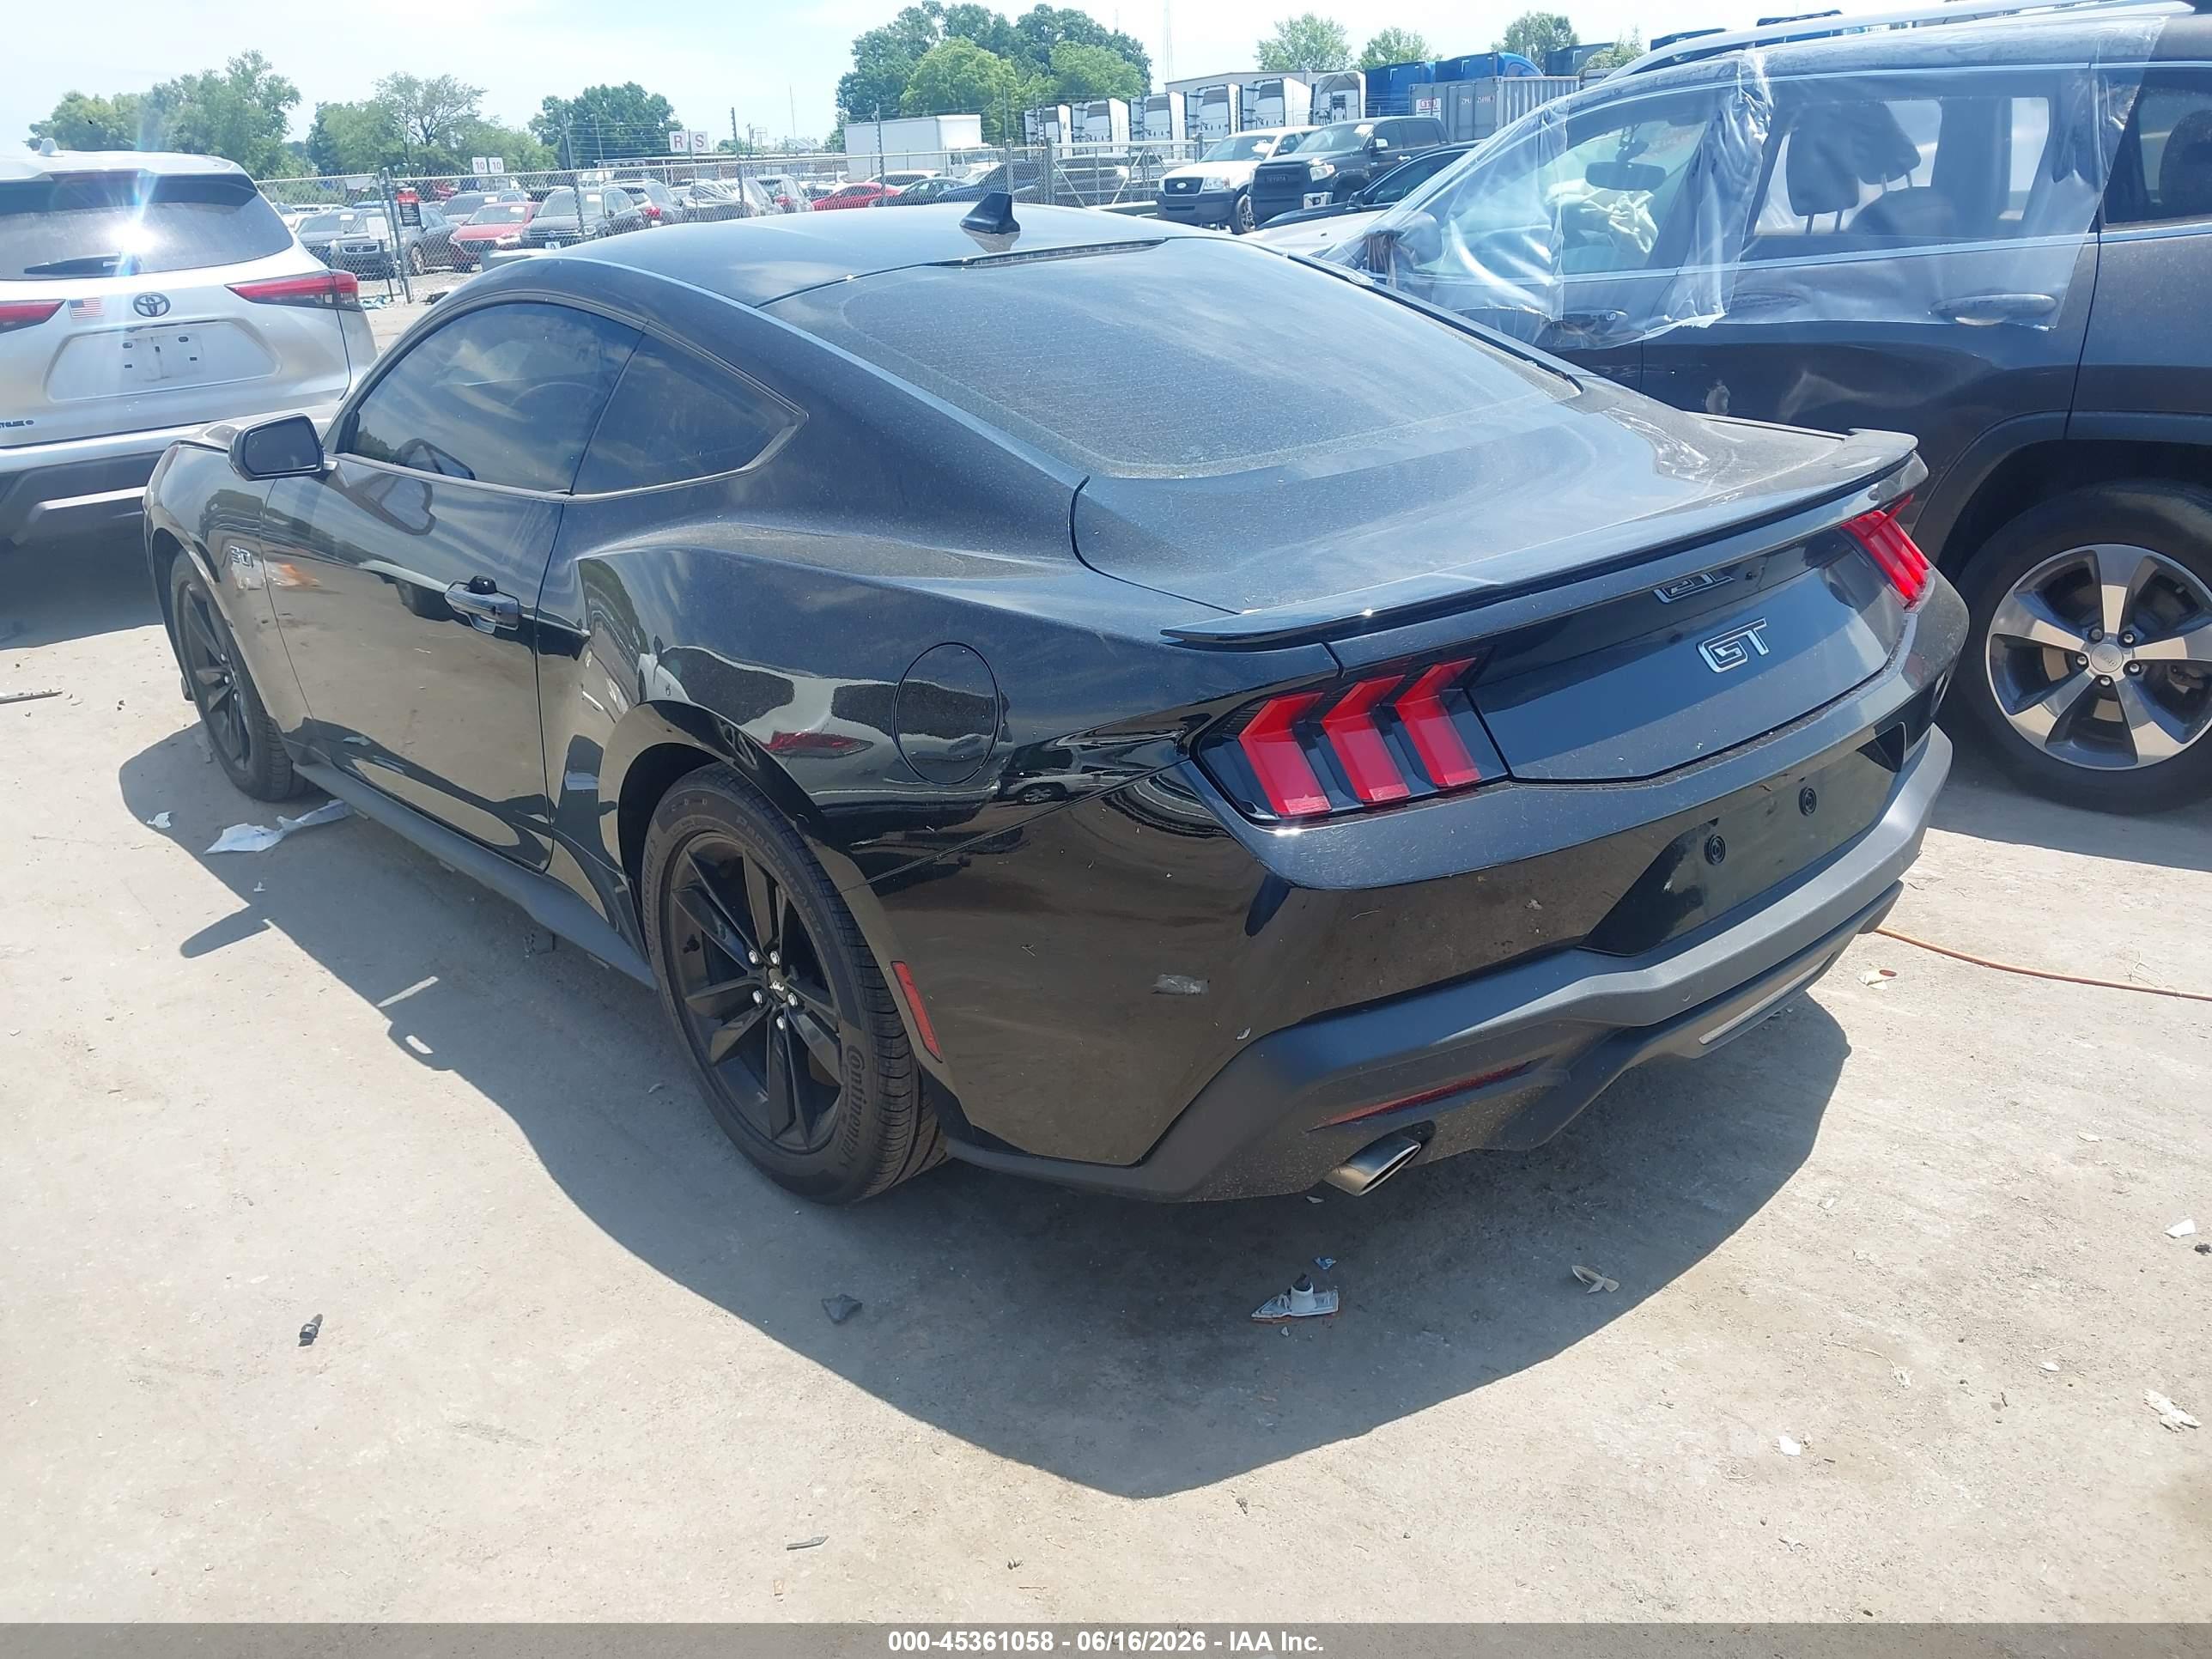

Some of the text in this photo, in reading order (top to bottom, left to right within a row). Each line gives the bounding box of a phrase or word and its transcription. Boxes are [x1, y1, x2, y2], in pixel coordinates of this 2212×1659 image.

[673, 135, 684, 149] R
[695, 134, 704, 148] S
[475, 161, 485, 170] 10
[491, 161, 501, 170] 10
[1696, 617, 1770, 673] GT
